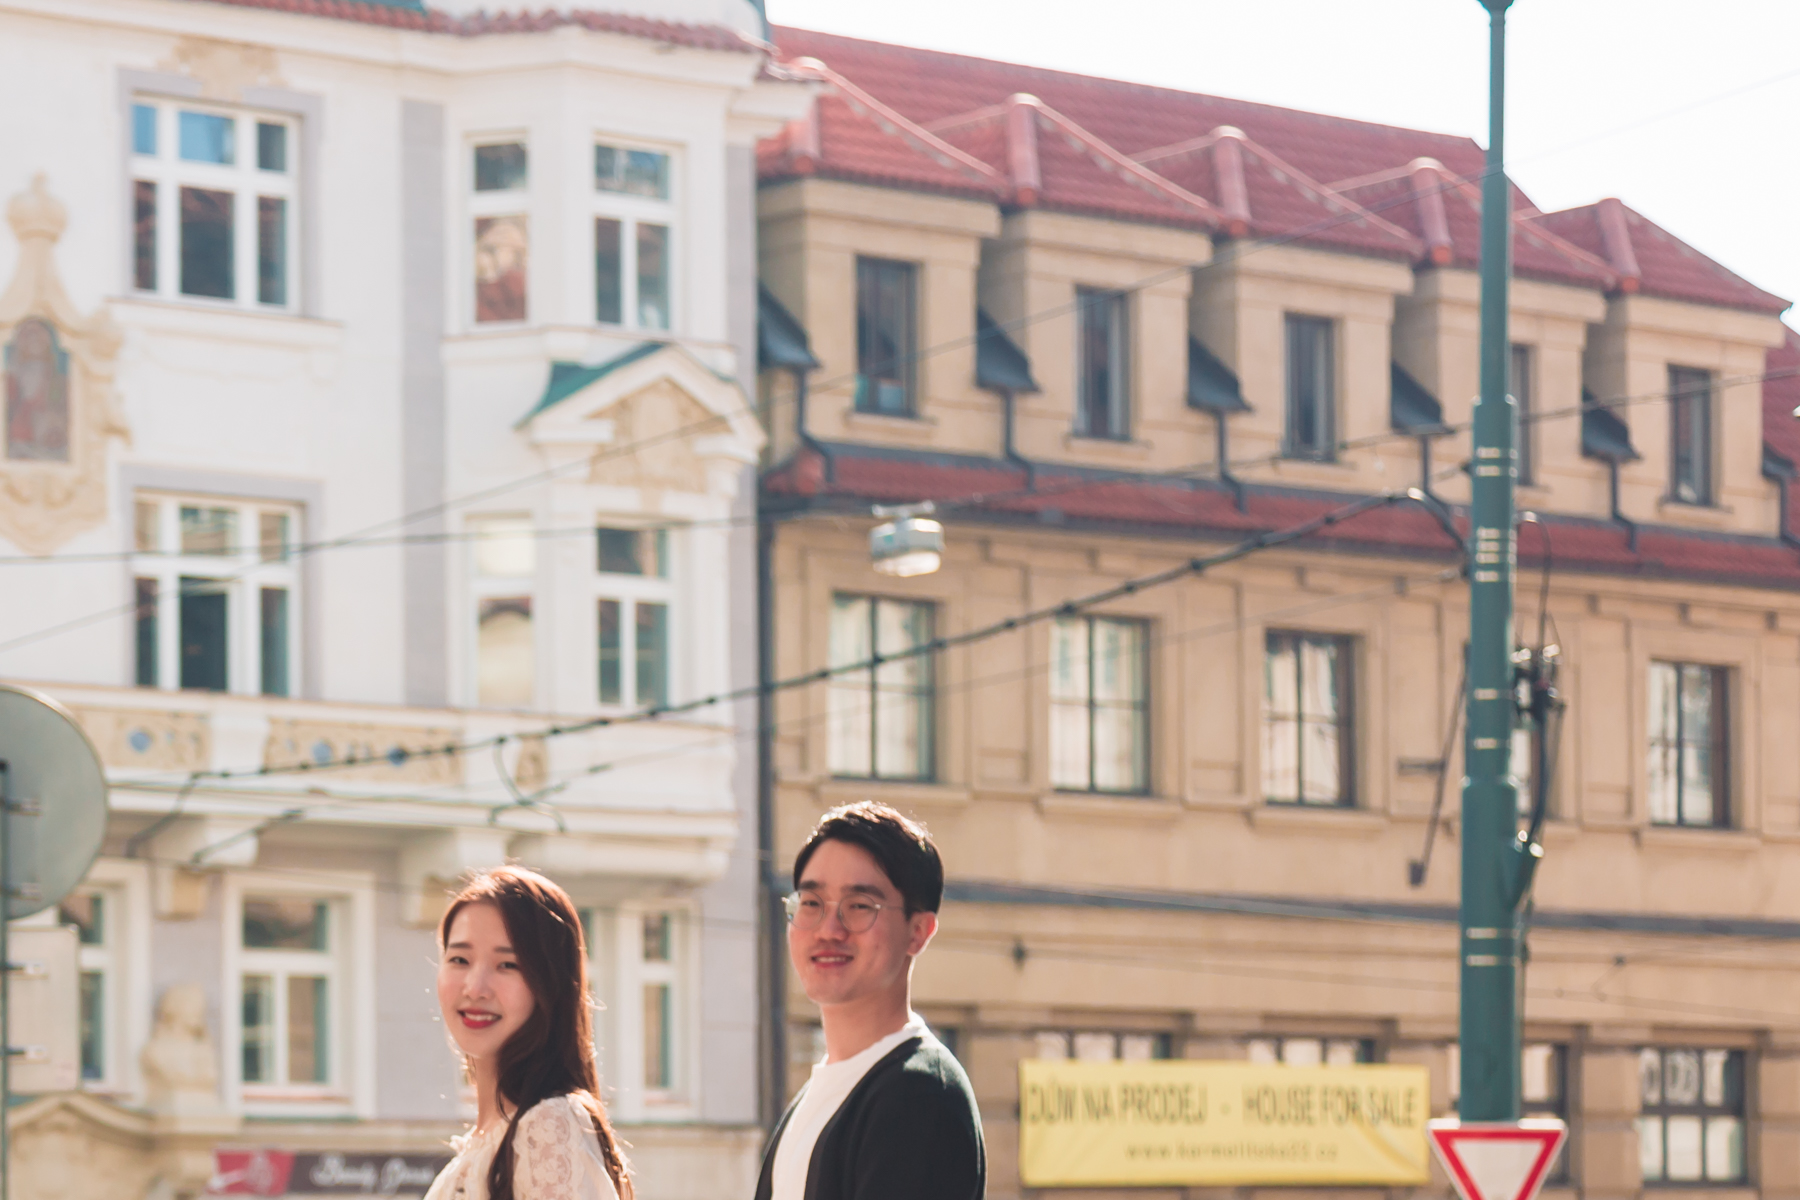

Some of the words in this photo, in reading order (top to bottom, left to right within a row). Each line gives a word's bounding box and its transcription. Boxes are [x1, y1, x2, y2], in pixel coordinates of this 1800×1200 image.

[1081, 1083, 1114, 1123] NA
[1118, 1082, 1207, 1126] PRODEJ
[1243, 1084, 1315, 1127] HOUSE
[1319, 1085, 1364, 1125] FOR
[1366, 1086, 1417, 1127] SALE
